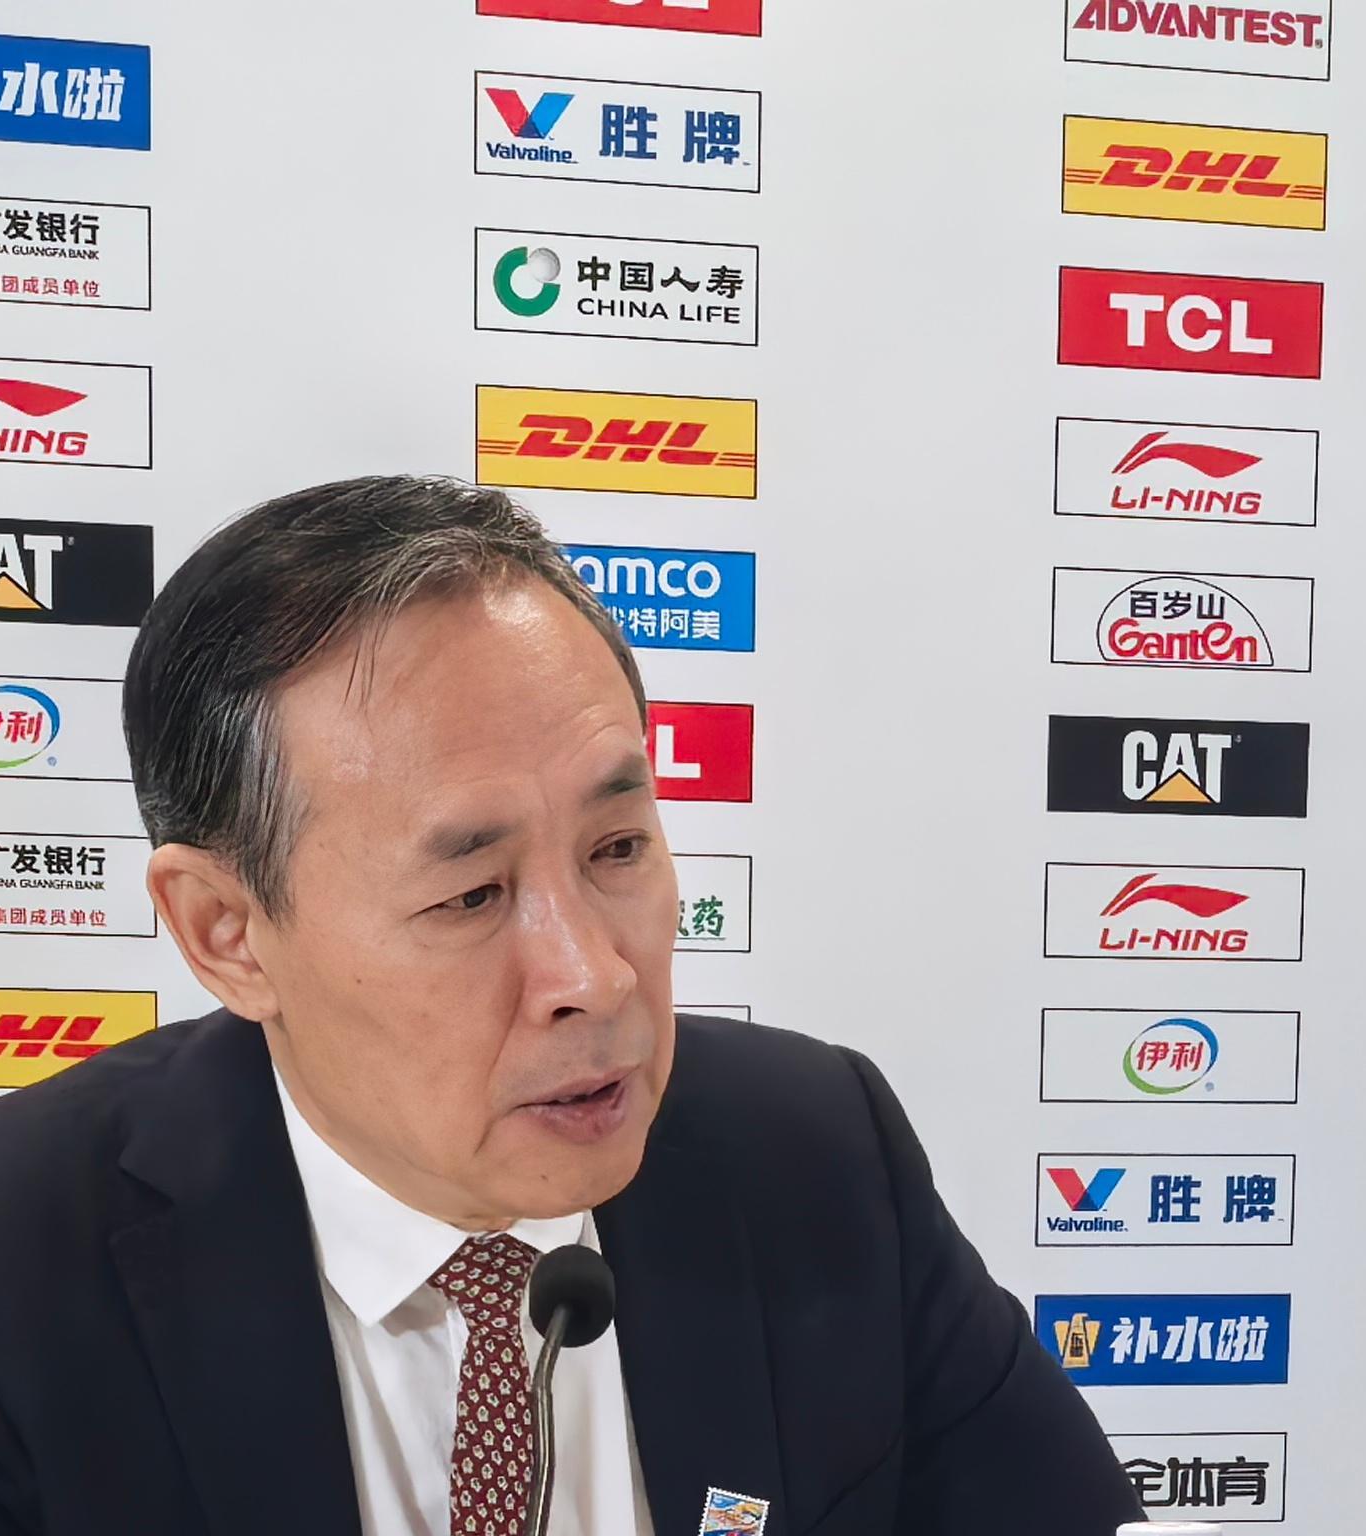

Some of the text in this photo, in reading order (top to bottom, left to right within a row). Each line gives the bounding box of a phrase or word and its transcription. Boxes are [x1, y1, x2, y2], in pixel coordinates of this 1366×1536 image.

[1073, 0, 1323, 48] ADVANTEST
[486, 142, 573, 163] Valvoline
[599, 104, 740, 165] 胜牌
[1099, 145, 1291, 197] DHL
[578, 256, 744, 299] 中国人寿
[578, 298, 740, 324] CHINA LIFE
[1110, 293, 1272, 354] TCL
[515, 415, 719, 465] DHL
[1111, 486, 1261, 515] LI-NING
[565, 555, 722, 598] amco
[1130, 590, 1225, 620] 百岁山
[1123, 730, 1231, 803] CAT
[1099, 928, 1248, 952] LI-NING
[1137, 1041, 1203, 1071] 伊利
[1148, 1175, 1276, 1223] 胜牌
[1047, 1217, 1124, 1232] Valvoline
[1110, 1316, 1269, 1363] 补水啦
[1122, 1456, 1270, 1507] 全体育
